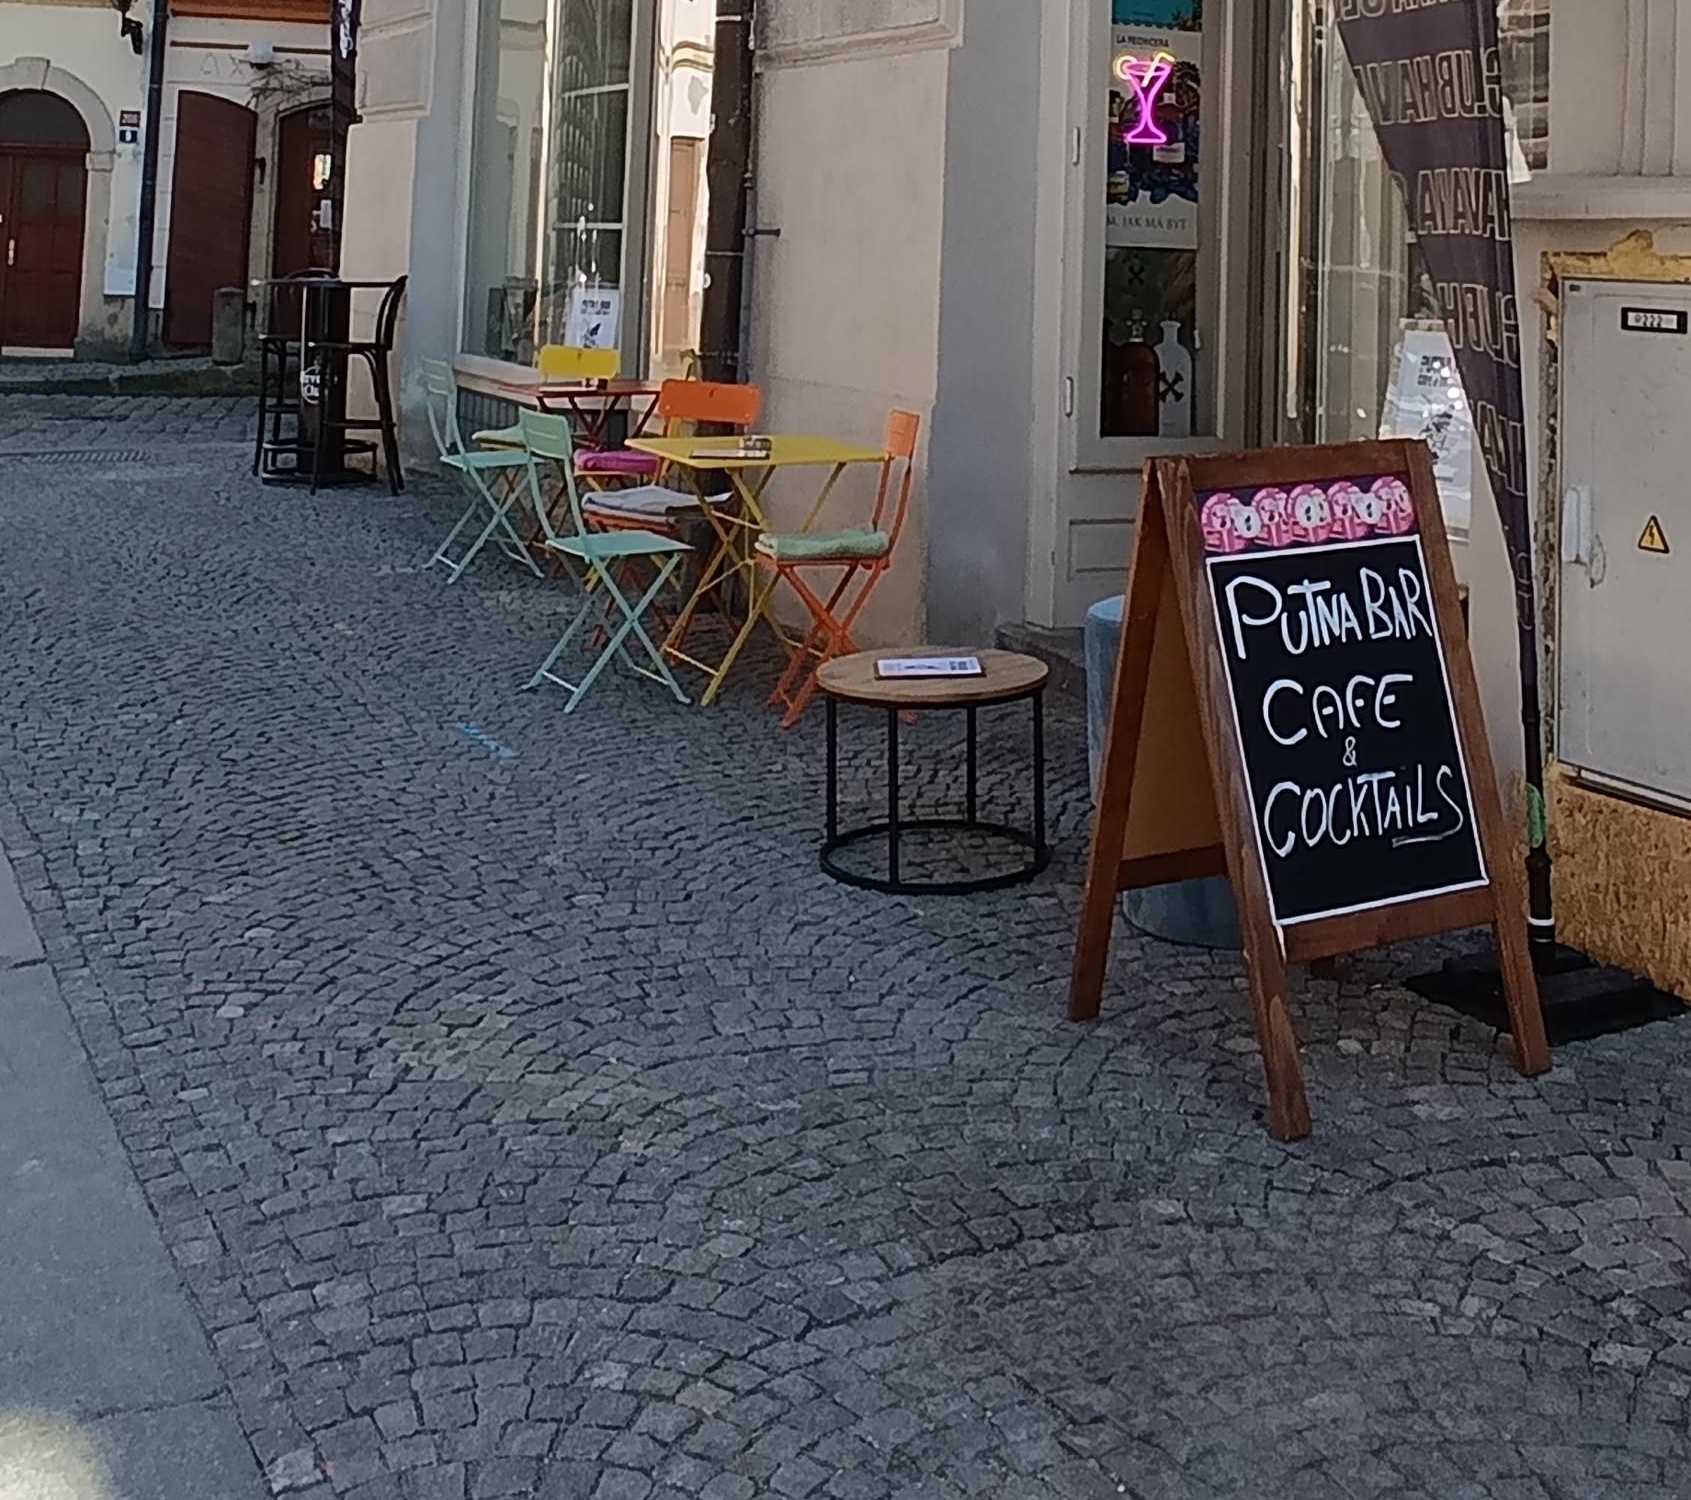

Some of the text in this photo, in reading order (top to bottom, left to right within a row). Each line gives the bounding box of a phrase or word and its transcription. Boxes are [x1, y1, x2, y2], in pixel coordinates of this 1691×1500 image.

[1225, 574, 1363, 661] PUTNA
[1360, 567, 1433, 640] BAR
[1262, 673, 1414, 746] CAFE
[1341, 735, 1358, 767] &
[1264, 763, 1464, 858] COCKTAILS
